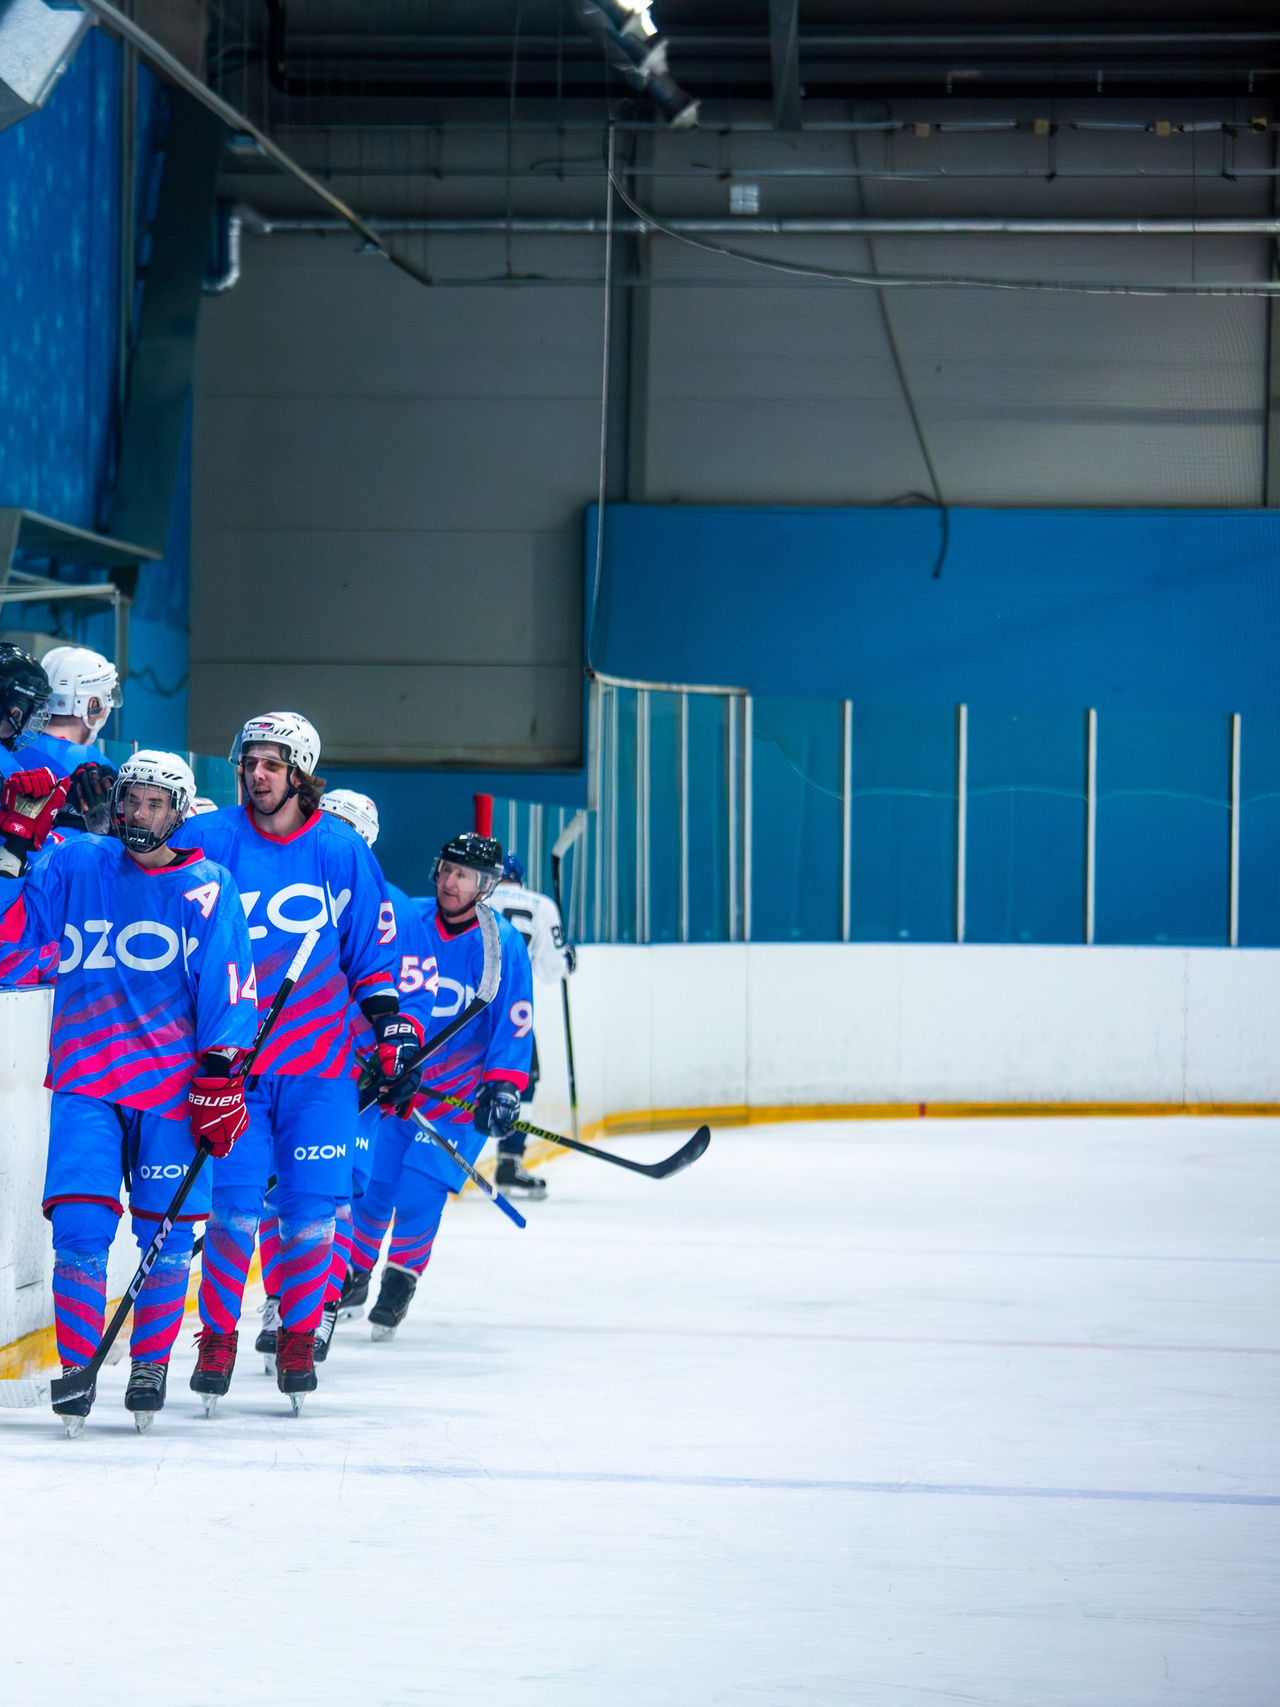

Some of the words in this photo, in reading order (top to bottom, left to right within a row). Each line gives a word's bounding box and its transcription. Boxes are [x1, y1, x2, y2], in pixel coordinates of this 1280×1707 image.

[182, 880, 220, 919] A
[376, 901, 397, 944] 9
[227, 962, 258, 1007] 14
[397, 955, 439, 997] 52
[509, 1000, 533, 1039] 9
[294, 1144, 346, 1161] OZON
[129, 1216, 173, 1301] CCM
